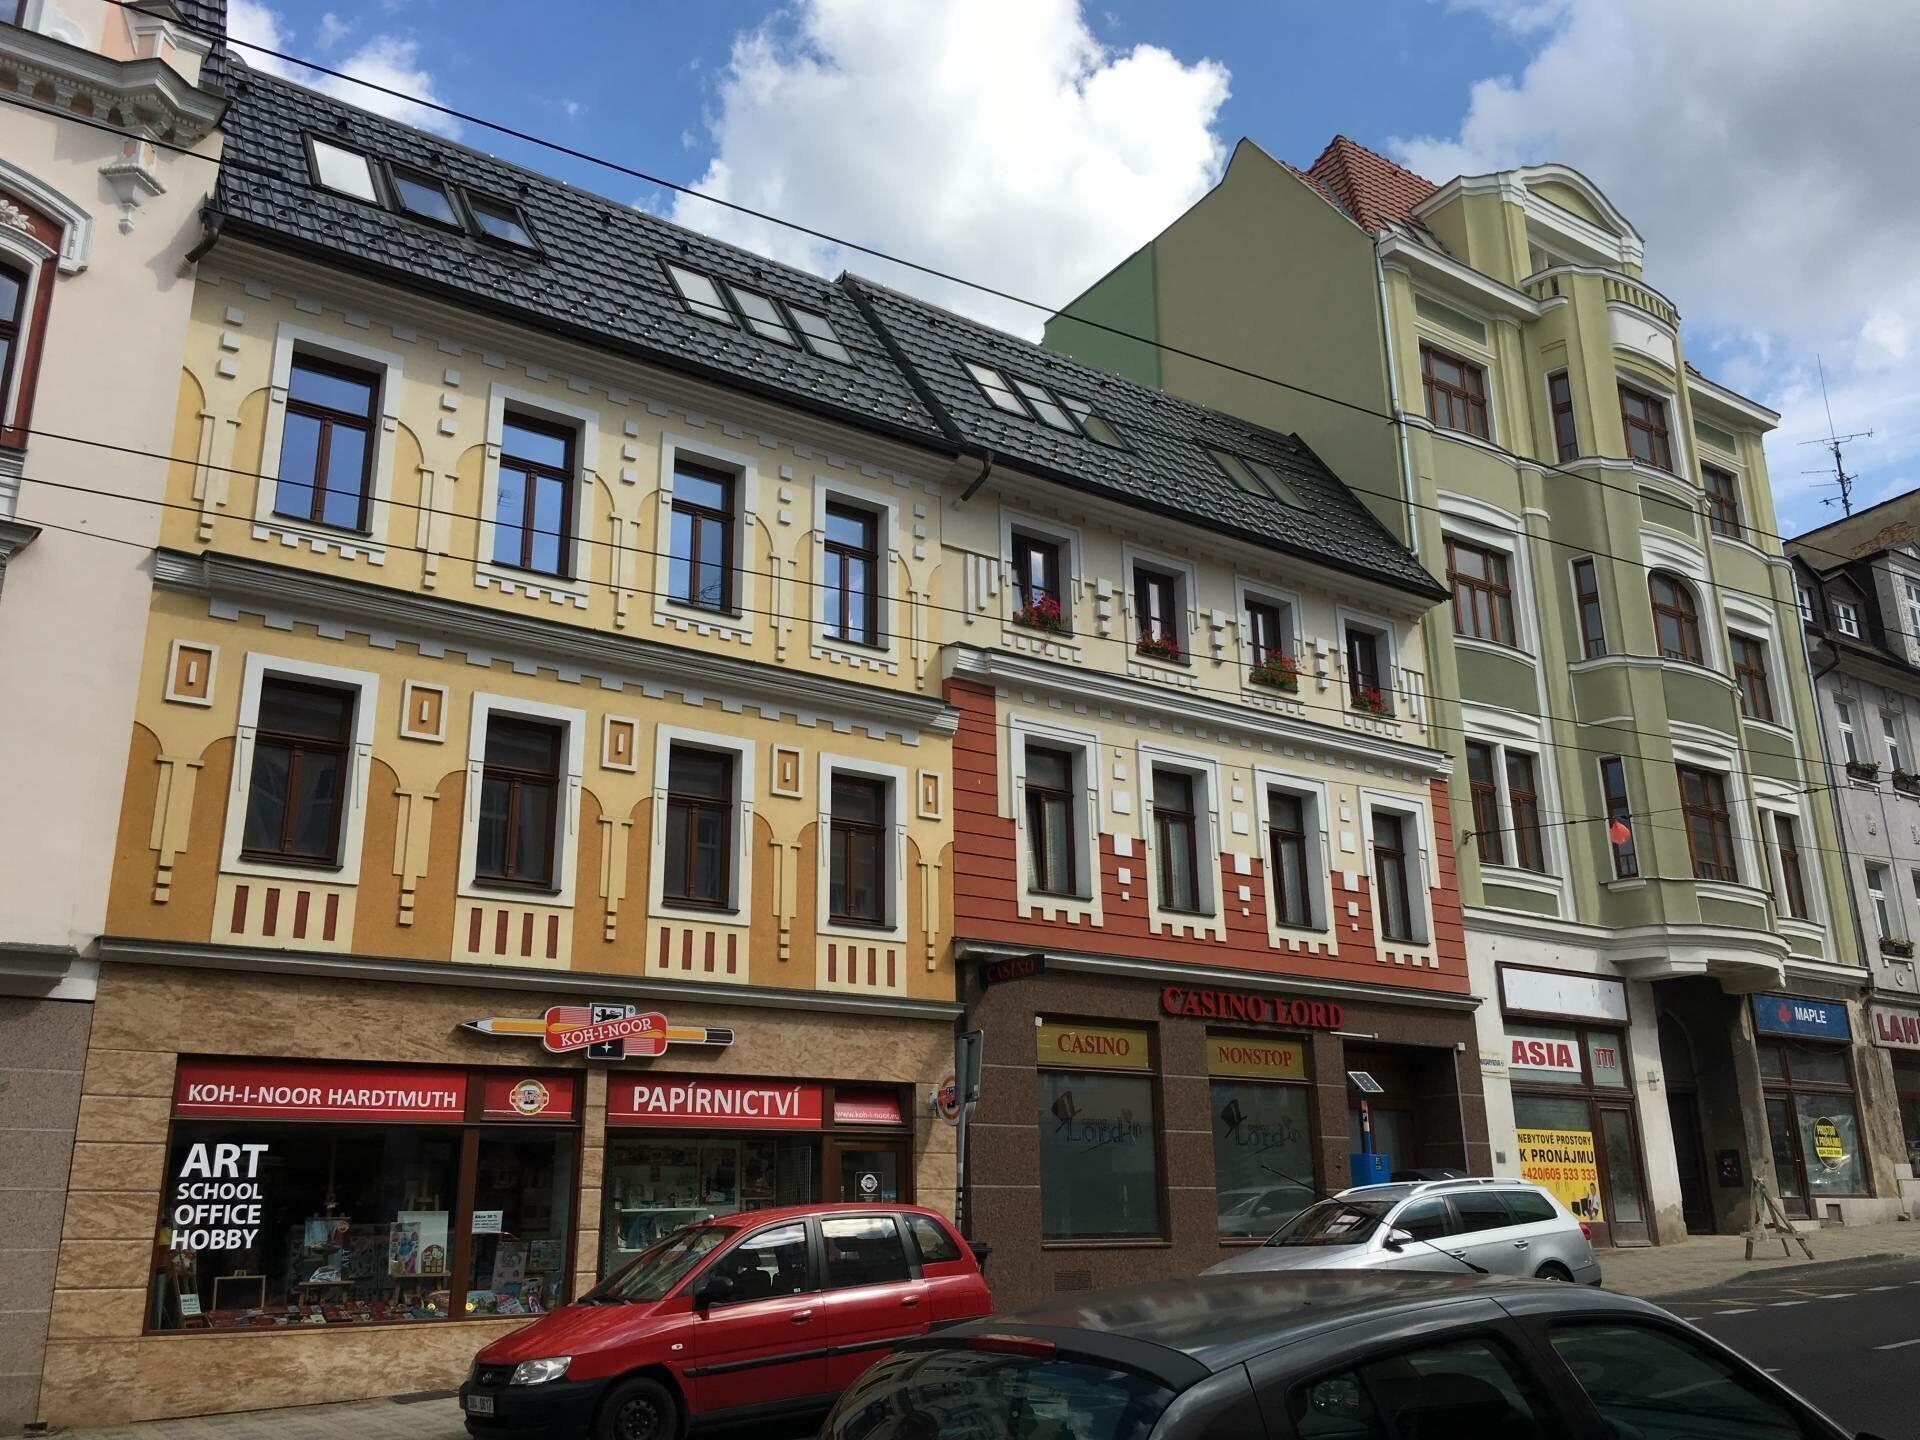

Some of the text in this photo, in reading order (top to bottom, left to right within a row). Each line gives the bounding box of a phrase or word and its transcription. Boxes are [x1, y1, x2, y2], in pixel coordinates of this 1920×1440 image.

[987, 959, 1034, 981] CASINO
[1162, 987, 1344, 1029] CASINO LORD
[1794, 1006, 1827, 1025] MAPLE
[560, 1017, 653, 1048] KOH-I-NOOR
[1057, 1033, 1130, 1056] CASINO
[1511, 1040, 1575, 1068] ASIA
[1218, 1046, 1292, 1067] NONSTOP
[188, 1084, 457, 1108] KOH-I-NOOR HARDTMUTH
[632, 1082, 799, 1117] PAPÍRNICTVÍ
[1517, 1132, 1592, 1146] NEBYTOVÉ PROSTORY
[179, 1143, 269, 1178] ART
[1520, 1147, 1594, 1164] K PRONÁJMU
[1522, 1167, 1597, 1182] +420/605 533 333
[177, 1183, 263, 1200] SCHOOL
[174, 1204, 262, 1225] OFFICE
[170, 1228, 259, 1250] HOBBY
